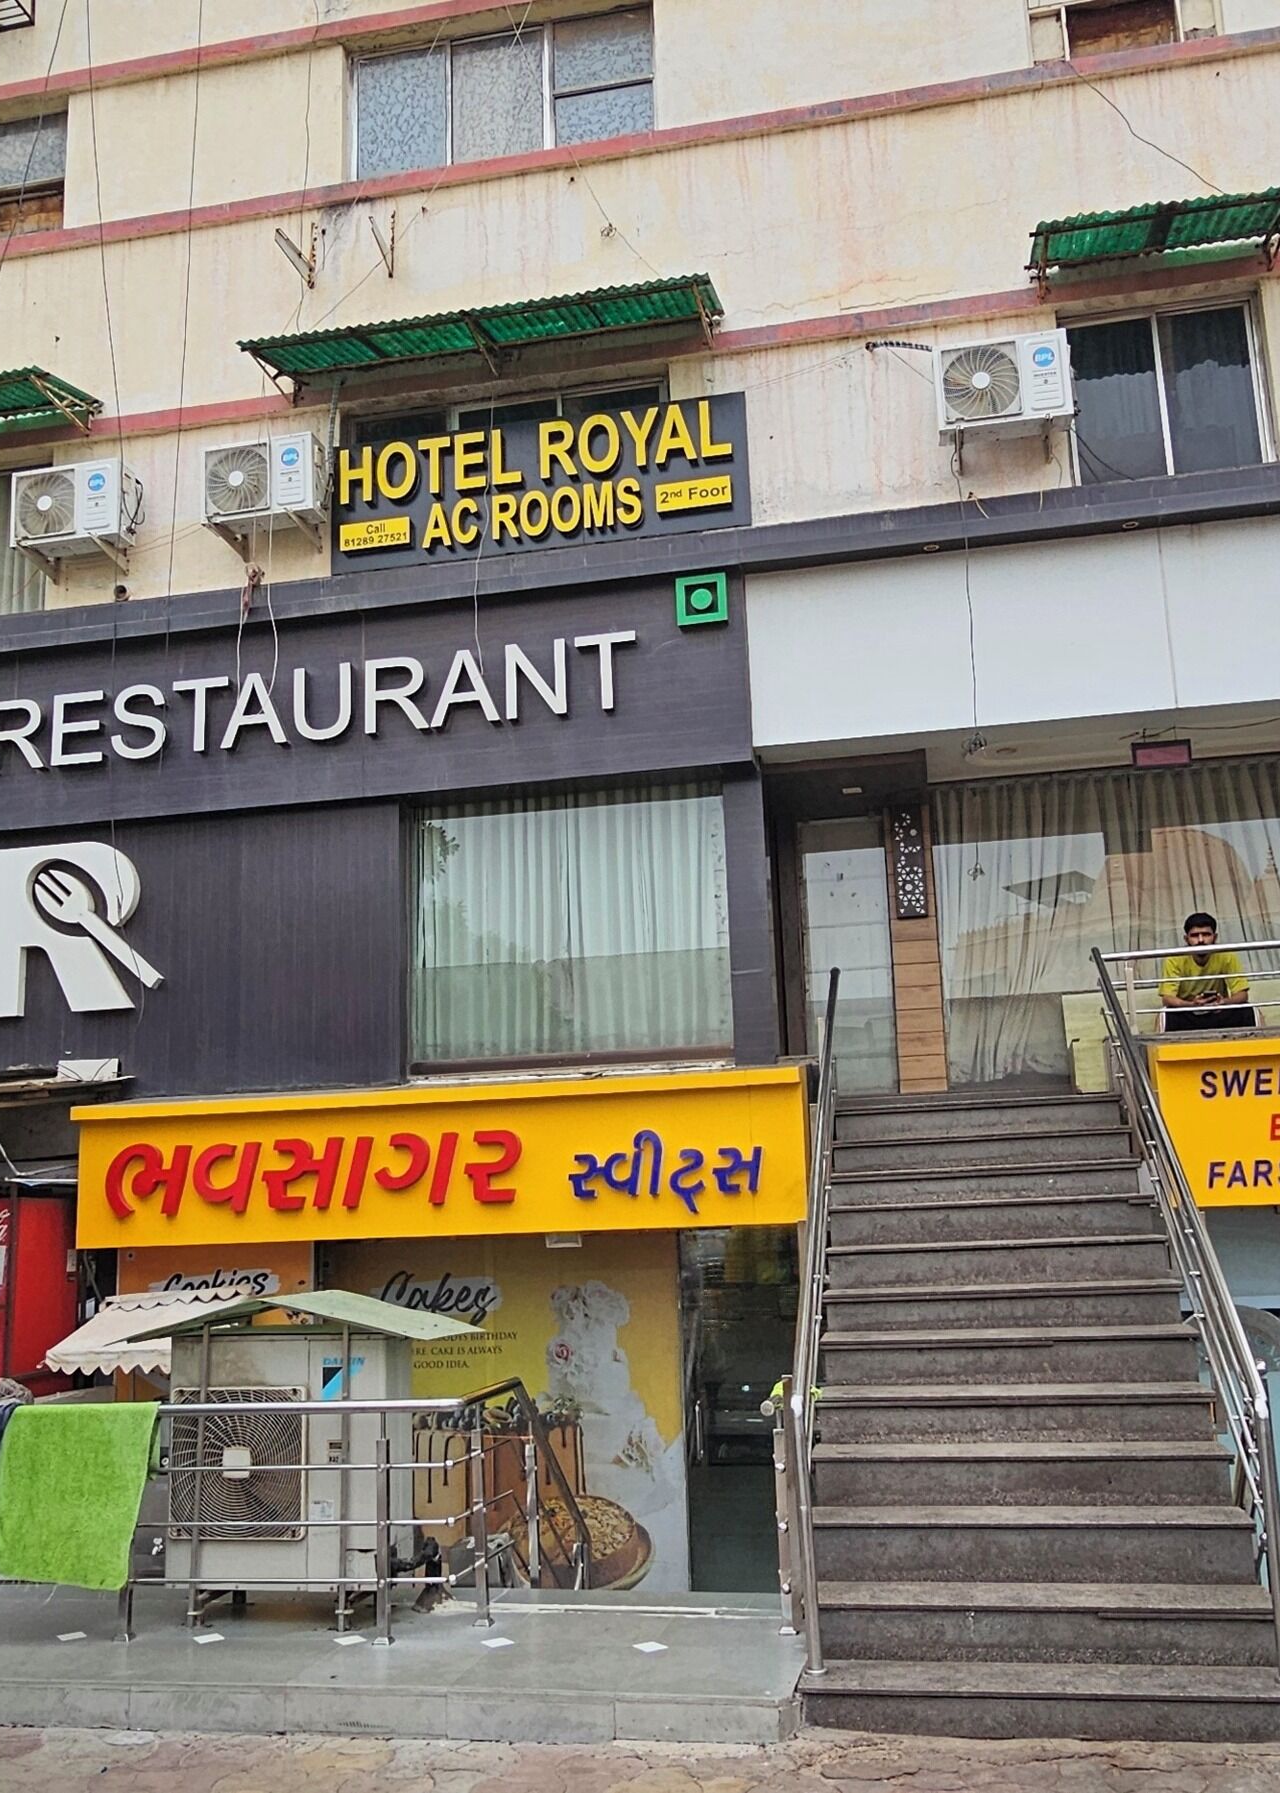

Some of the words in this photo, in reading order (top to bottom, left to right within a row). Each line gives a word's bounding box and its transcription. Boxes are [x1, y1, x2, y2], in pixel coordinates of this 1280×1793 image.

[340, 428, 524, 505] HOTEL
[539, 400, 734, 480] ROYAL
[659, 489, 683, 504] 2nd
[688, 484, 729, 500] Foor
[422, 499, 479, 550] AC
[491, 477, 643, 541] ROOMS
[365, 522, 386, 535] Call
[343, 536, 375, 548] 81289
[377, 531, 408, 544] 27521
[104, 1129, 522, 1219] ભવસાગર
[567, 1129, 763, 1215] સ્વીટ્સ
[380, 1270, 497, 1326] Cakes
[470, 1331, 519, 1342] BIRTHDAY
[430, 1346, 454, 1356] CAKE
[457, 1346, 466, 1355] IS
[467, 1344, 504, 1356] ALWAYS
[323, 1356, 366, 1367] DAIIN
[413, 1359, 444, 1370] GOOD
